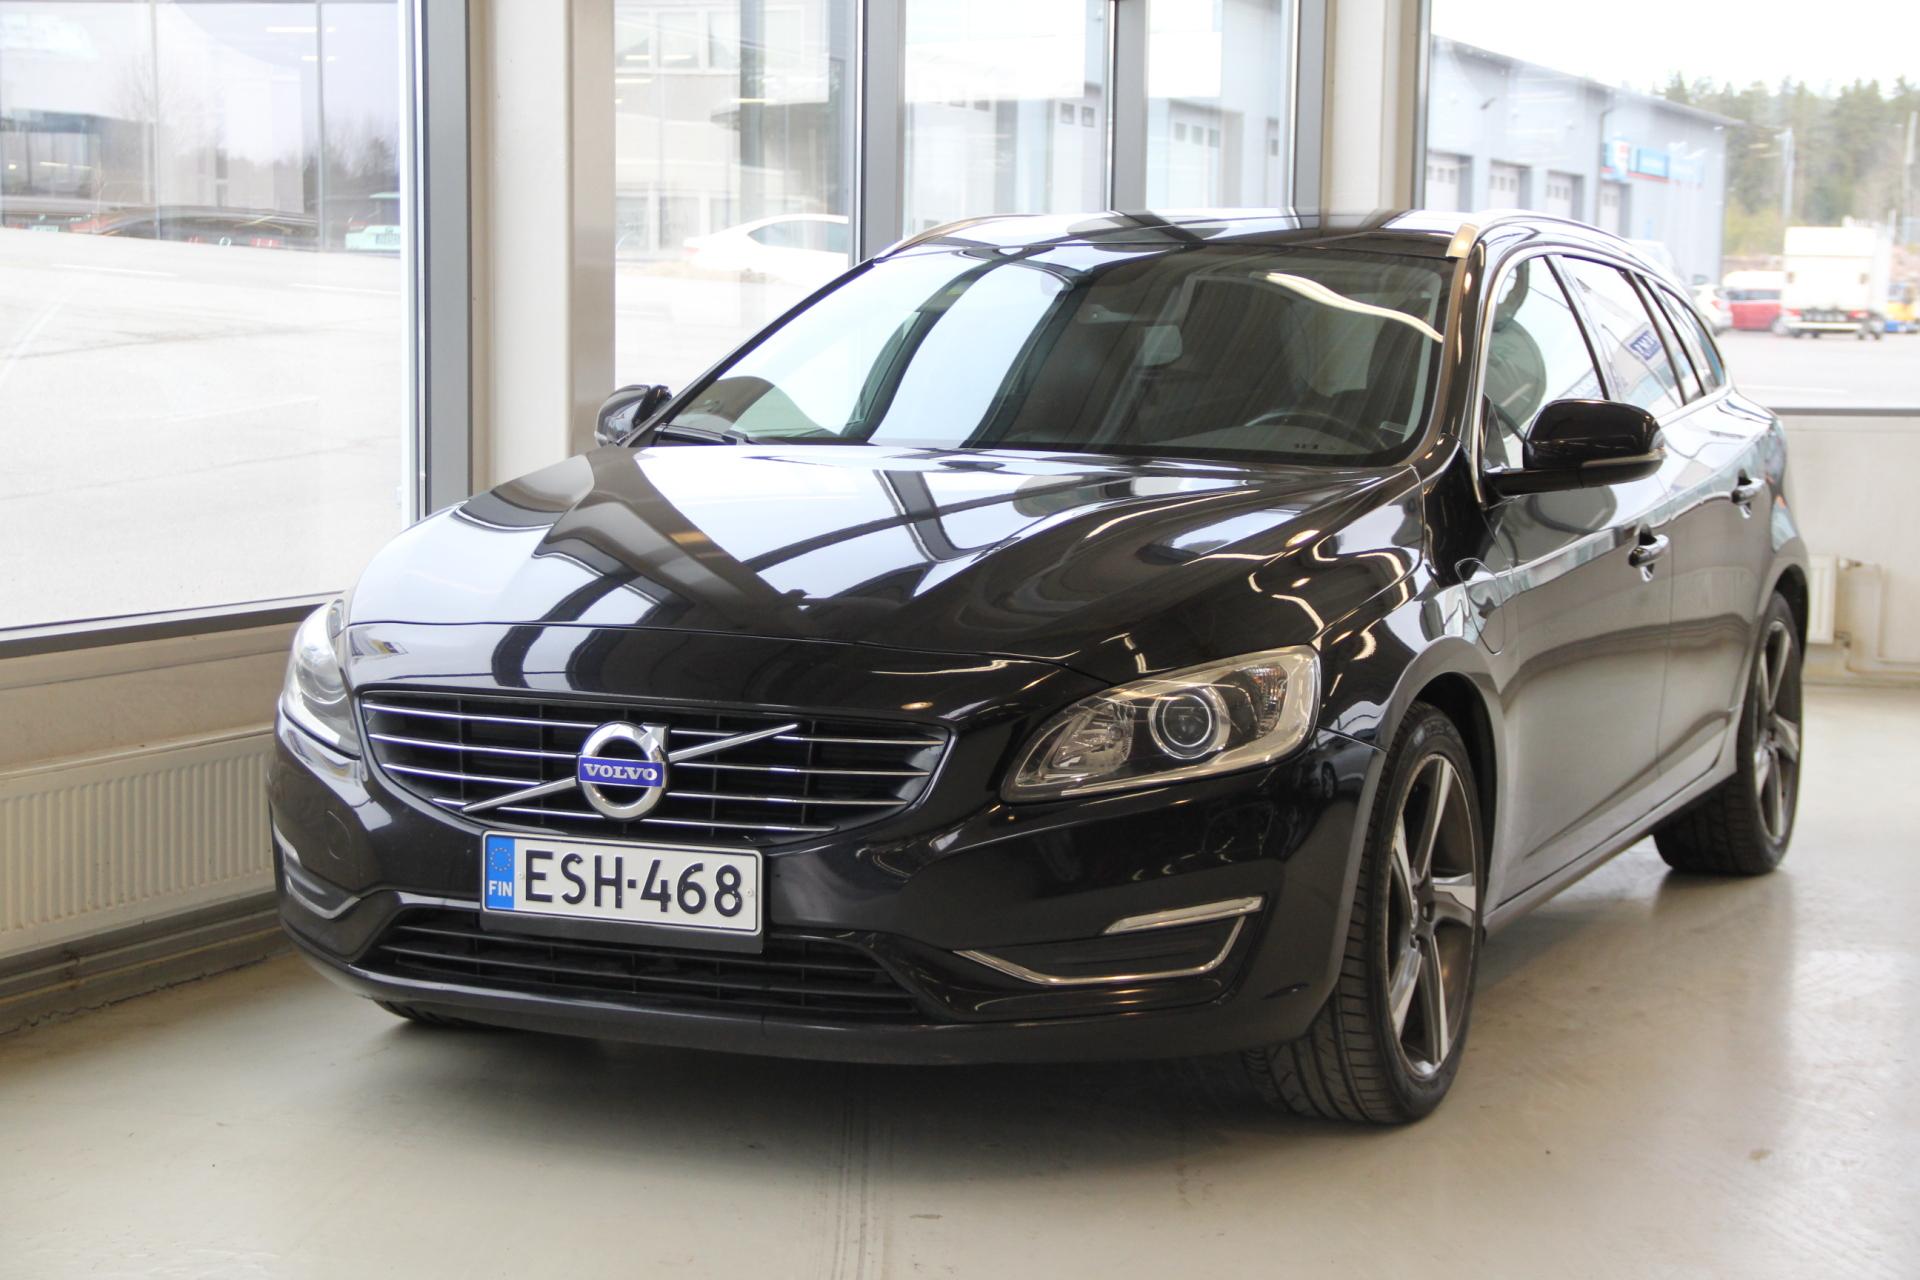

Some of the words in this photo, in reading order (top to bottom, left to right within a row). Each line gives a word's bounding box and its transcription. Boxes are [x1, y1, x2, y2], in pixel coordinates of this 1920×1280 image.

[583, 763, 658, 781] VOLVO
[488, 879, 513, 897] FIN
[525, 849, 743, 918] ESH-468
